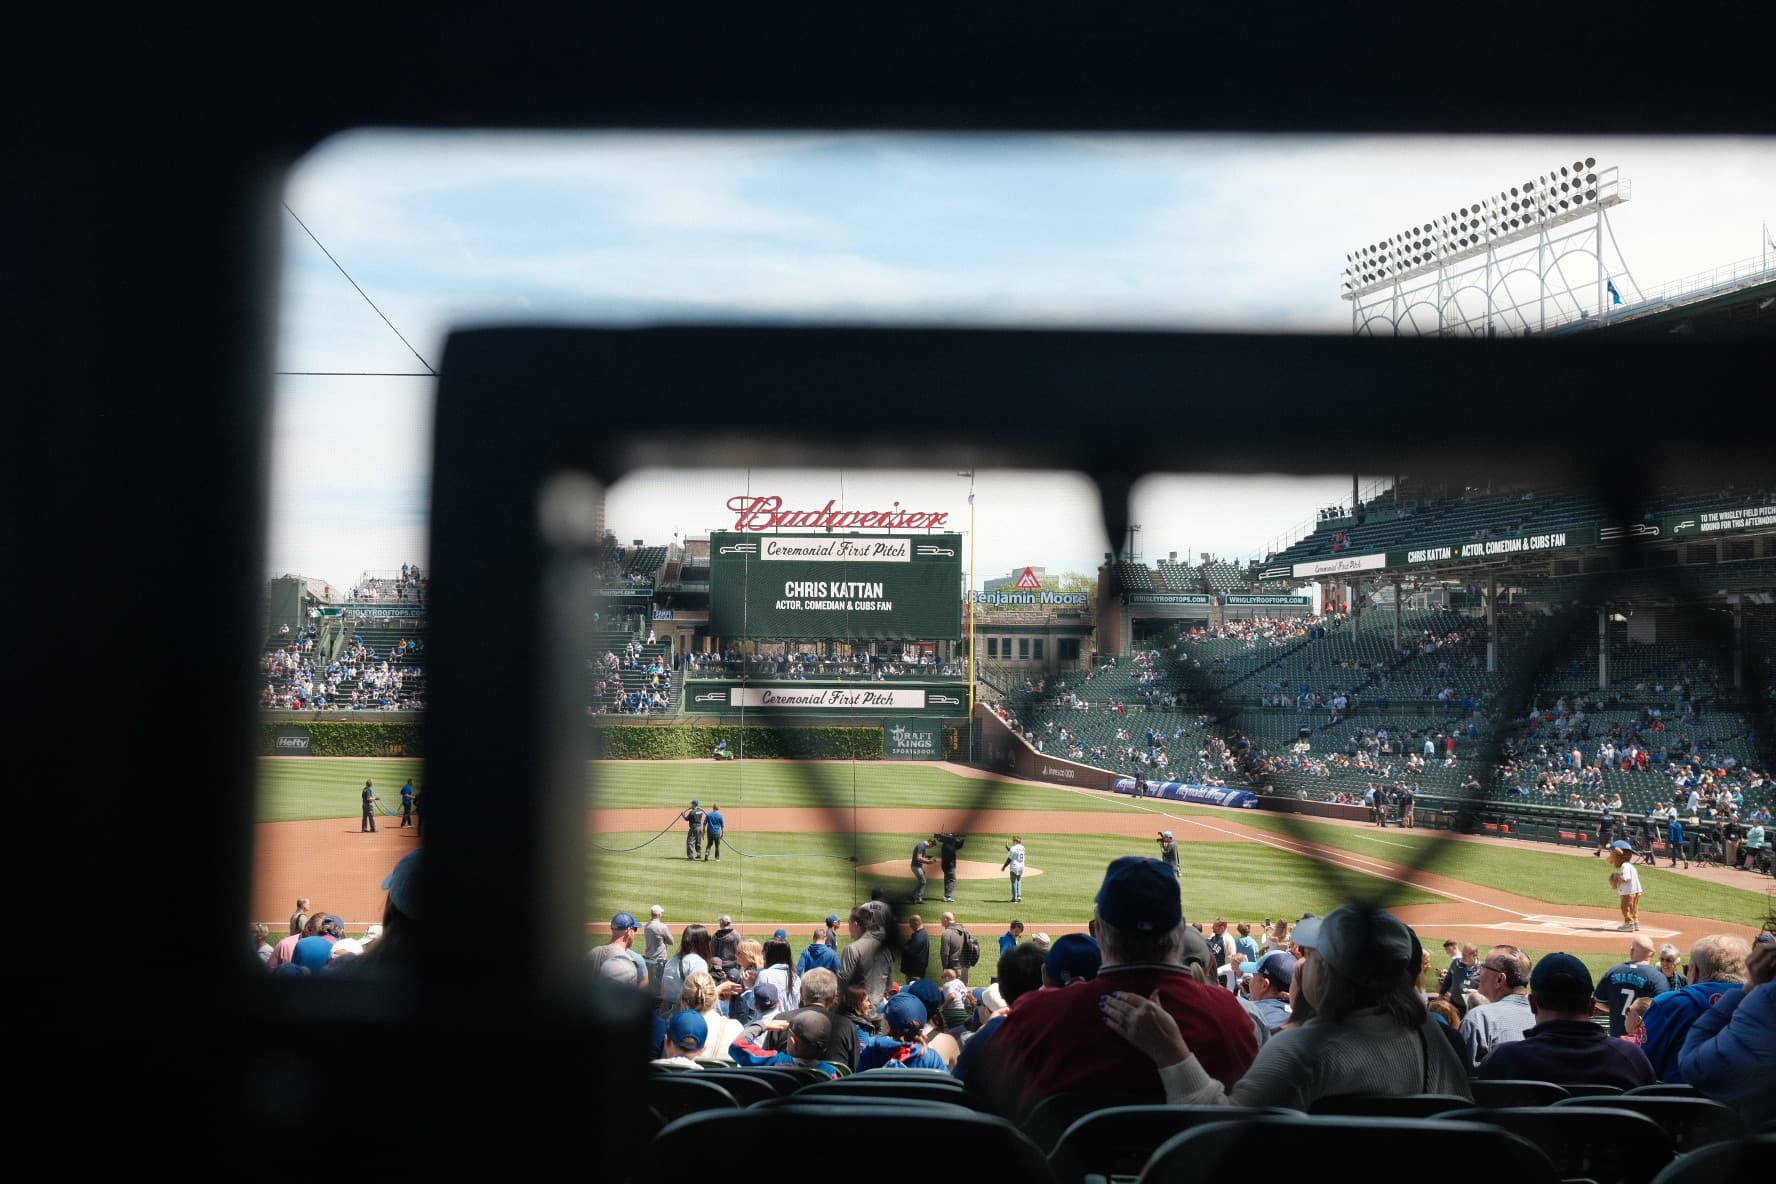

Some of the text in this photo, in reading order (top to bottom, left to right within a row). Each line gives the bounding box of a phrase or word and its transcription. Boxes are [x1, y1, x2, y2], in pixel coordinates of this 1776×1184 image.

[726, 495, 949, 532] Budweiser
[1700, 514, 1708, 522] TO
[1708, 512, 1719, 522] THE
[1719, 509, 1743, 520] WRIGLEY
[1743, 507, 1758, 518] FIELD
[1700, 522, 1720, 531] MOUND
[1720, 520, 1732, 530] FOR
[1732, 519, 1745, 529] THIS
[767, 541, 906, 558] Ceremonial First Pitch
[1407, 532, 1566, 563] CHRIS KATTAN ACTOR, COMEDIAN & CUBS FAN
[785, 581, 883, 599] CHRIS KATTAN
[776, 600, 892, 611] ACTOR, COMEDIAN & CUBS FAN
[969, 590, 1087, 607] Benjamin Moore
[1229, 595, 1304, 604] WRIGLEYROOFTOPS.COM
[762, 690, 896, 706] Ceremonial First Pitch
[892, 728, 933, 741] DRAFT
[278, 737, 307, 748] Hefty
[897, 740, 932, 748] KINGS
[1621, 989, 1635, 1016] 7
